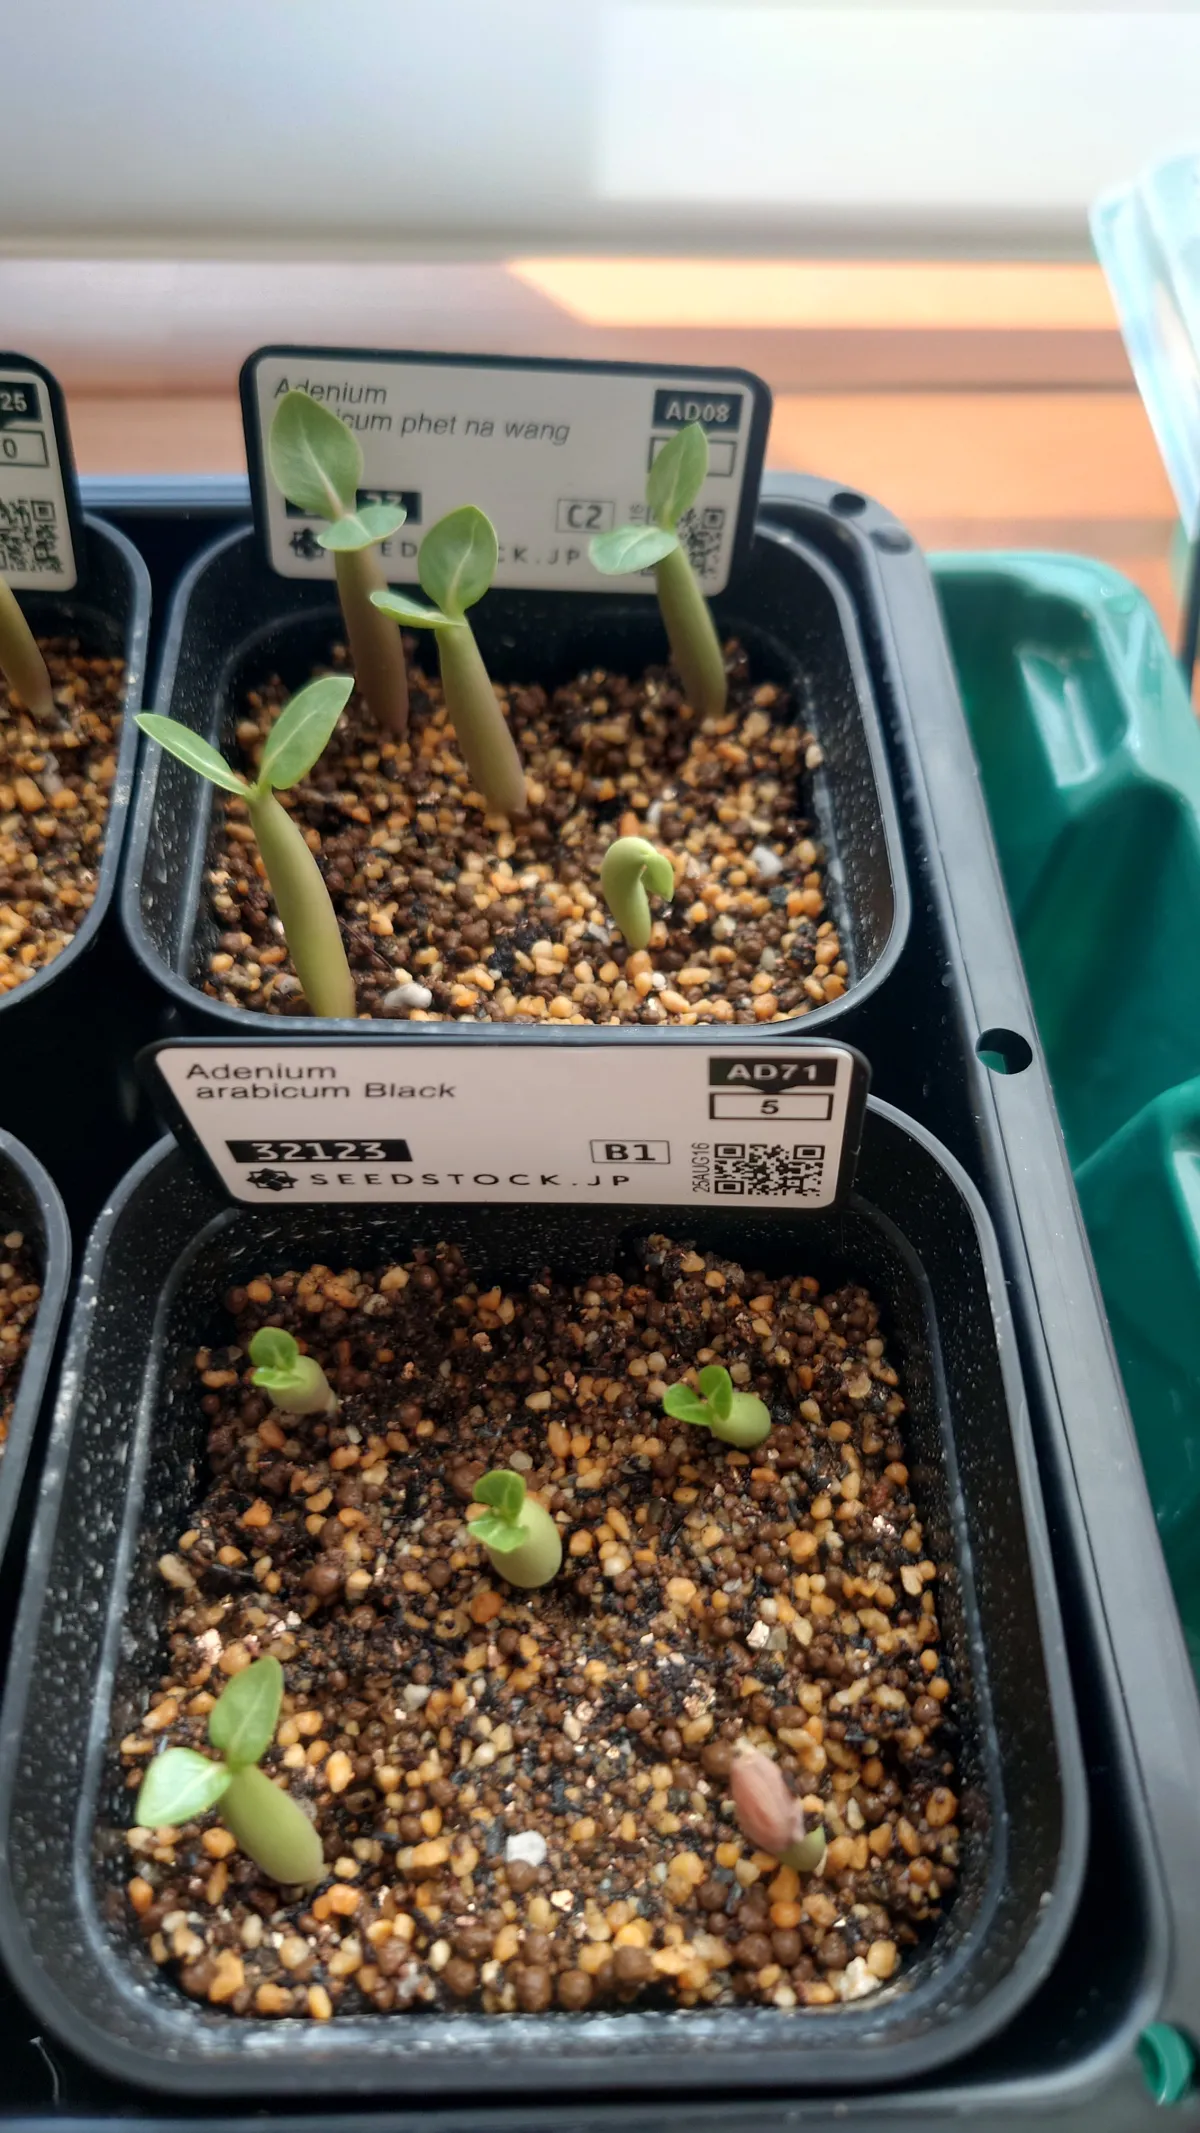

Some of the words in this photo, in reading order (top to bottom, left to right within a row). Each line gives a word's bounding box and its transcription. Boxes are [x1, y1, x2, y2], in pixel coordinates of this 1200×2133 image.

[665, 401, 731, 423] AD08
[400, 413, 456, 438] phet
[464, 419, 495, 437] na
[504, 420, 571, 447] wang
[567, 504, 603, 530] C2
[186, 1063, 338, 1080] Adenium
[726, 1063, 818, 1081] AD71
[196, 1083, 350, 1099] arabicum
[364, 1082, 457, 1098] Black
[760, 1099, 780, 1115] 5
[251, 1142, 387, 1161] 32123
[604, 1143, 656, 1161] B1
[691, 1142, 710, 1193] 25AUG16
[310, 1173, 630, 1187] SEEDSTOCK.JP
